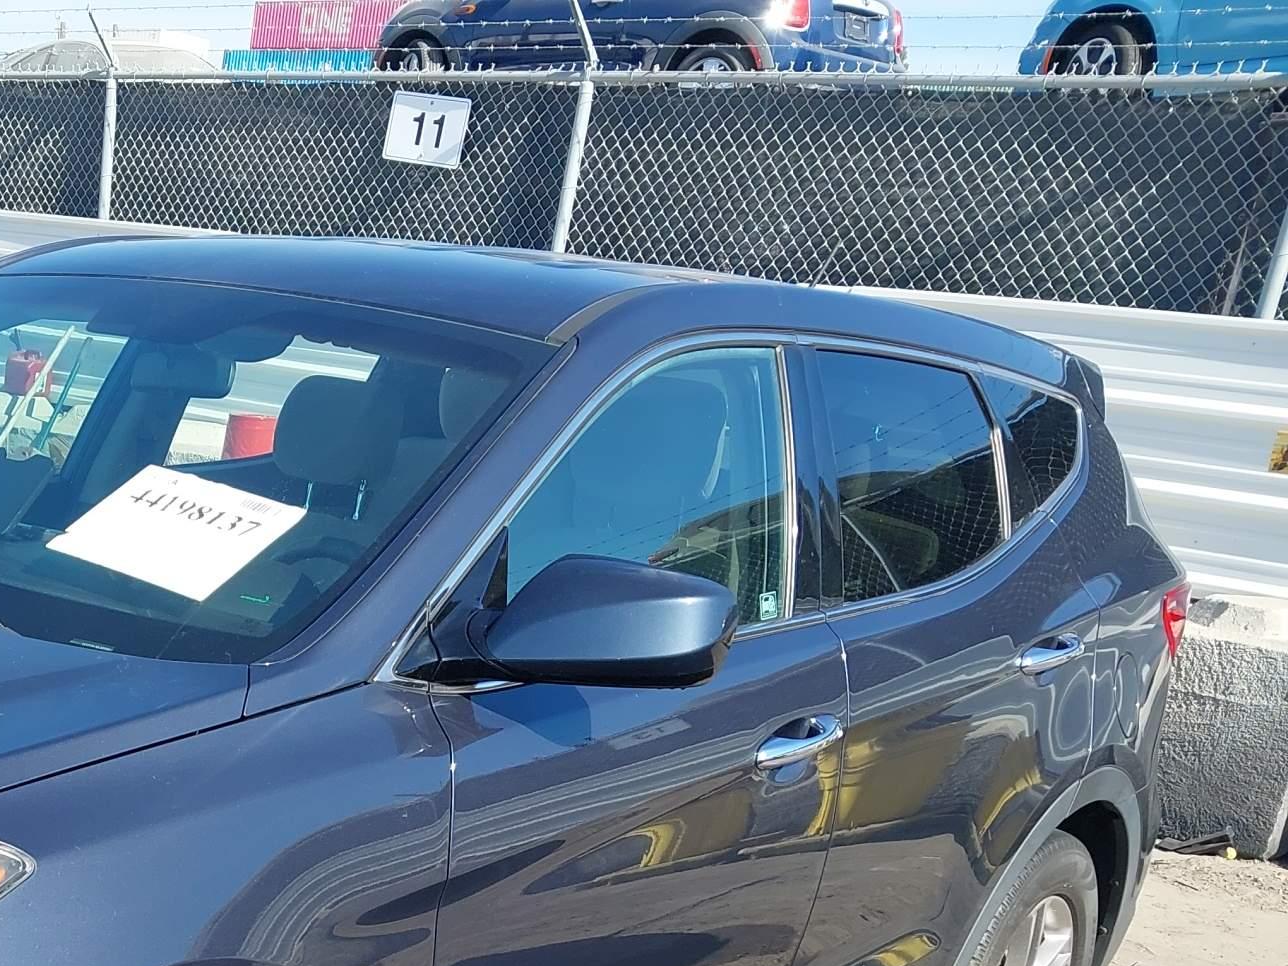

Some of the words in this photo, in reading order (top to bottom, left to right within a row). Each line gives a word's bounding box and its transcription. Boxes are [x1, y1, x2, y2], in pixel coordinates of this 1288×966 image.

[300, 5, 352, 33] ONE
[413, 112, 446, 149] 11
[129, 489, 263, 537] 44198137
